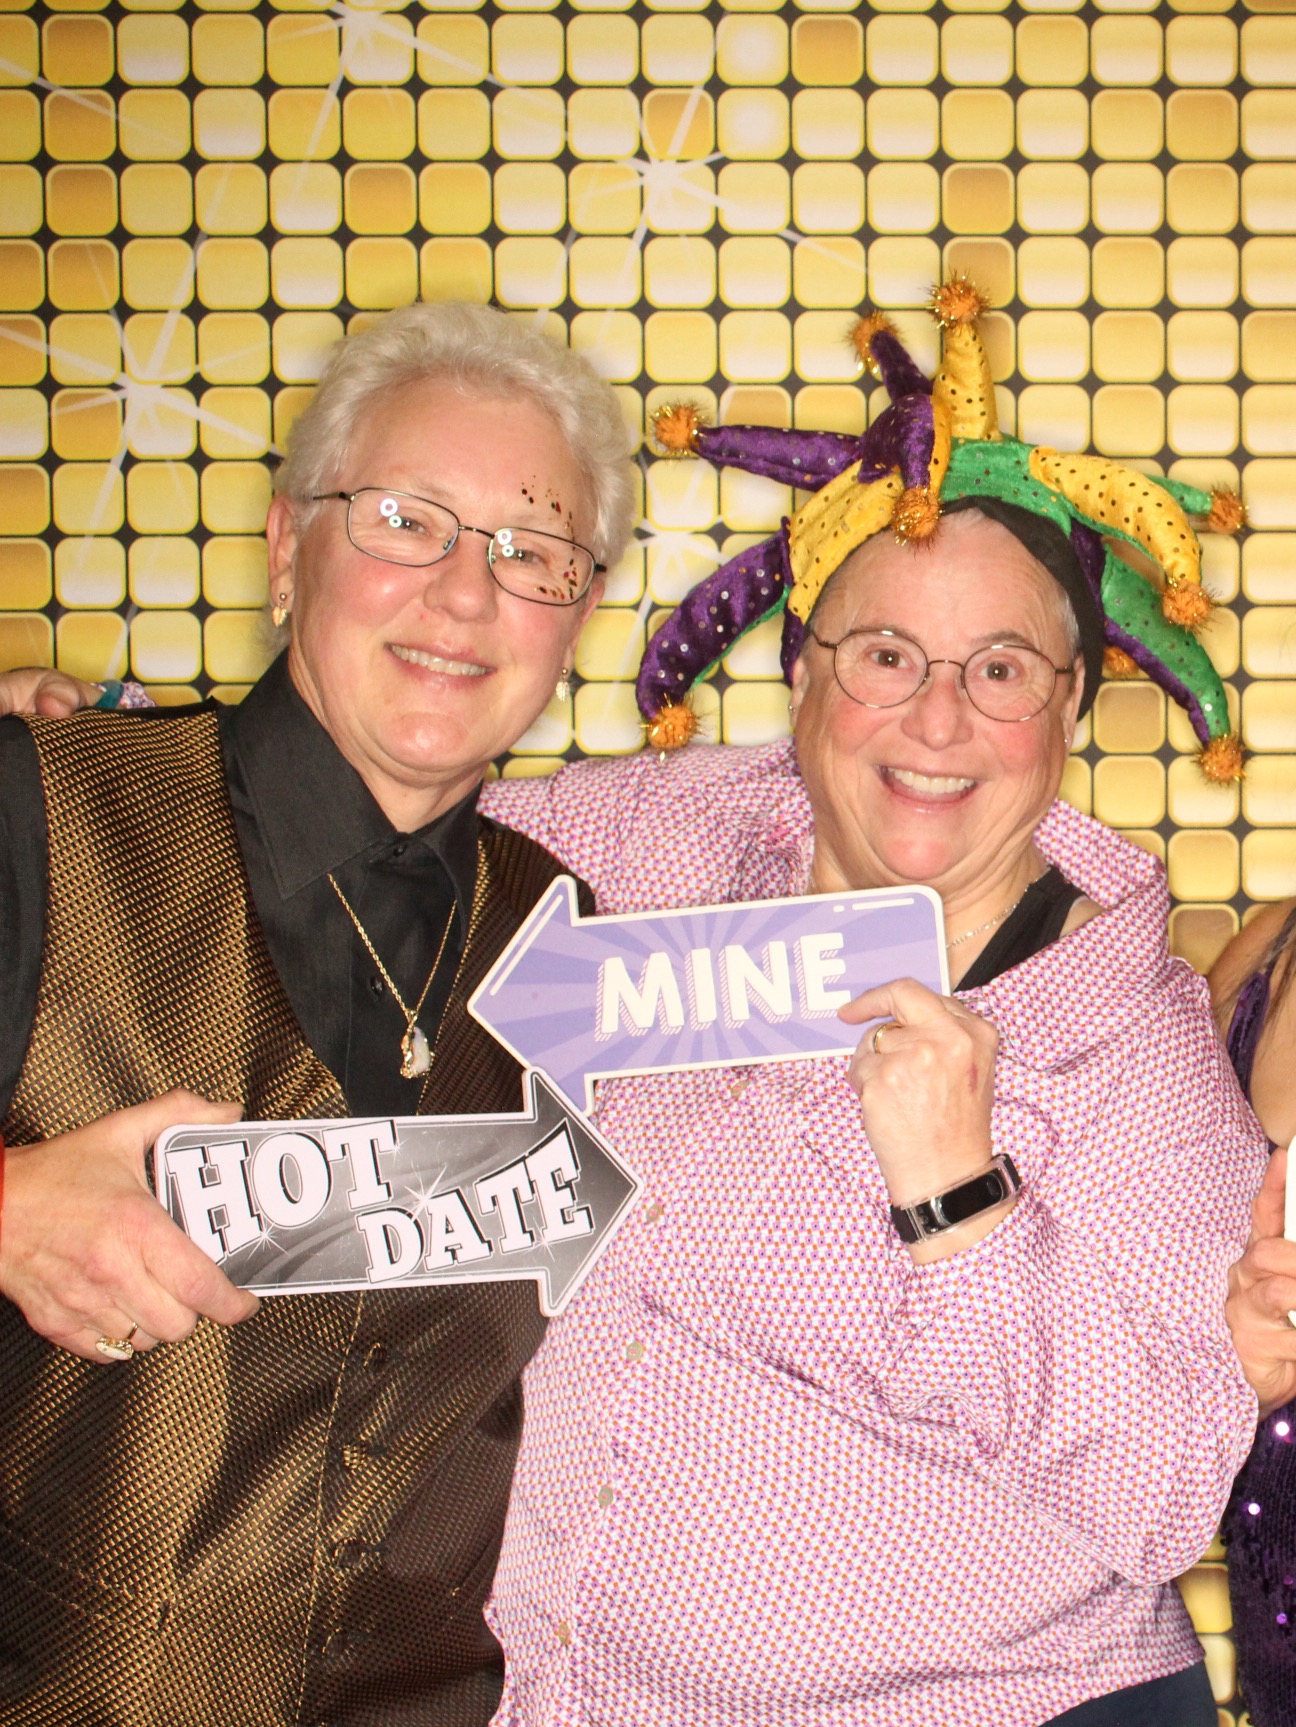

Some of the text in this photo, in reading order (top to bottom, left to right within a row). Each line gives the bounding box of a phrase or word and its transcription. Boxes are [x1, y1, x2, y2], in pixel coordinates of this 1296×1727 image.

[594, 931, 852, 1042] MINE
[164, 1119, 398, 1265] HOT
[355, 1117, 596, 1284] DATE
